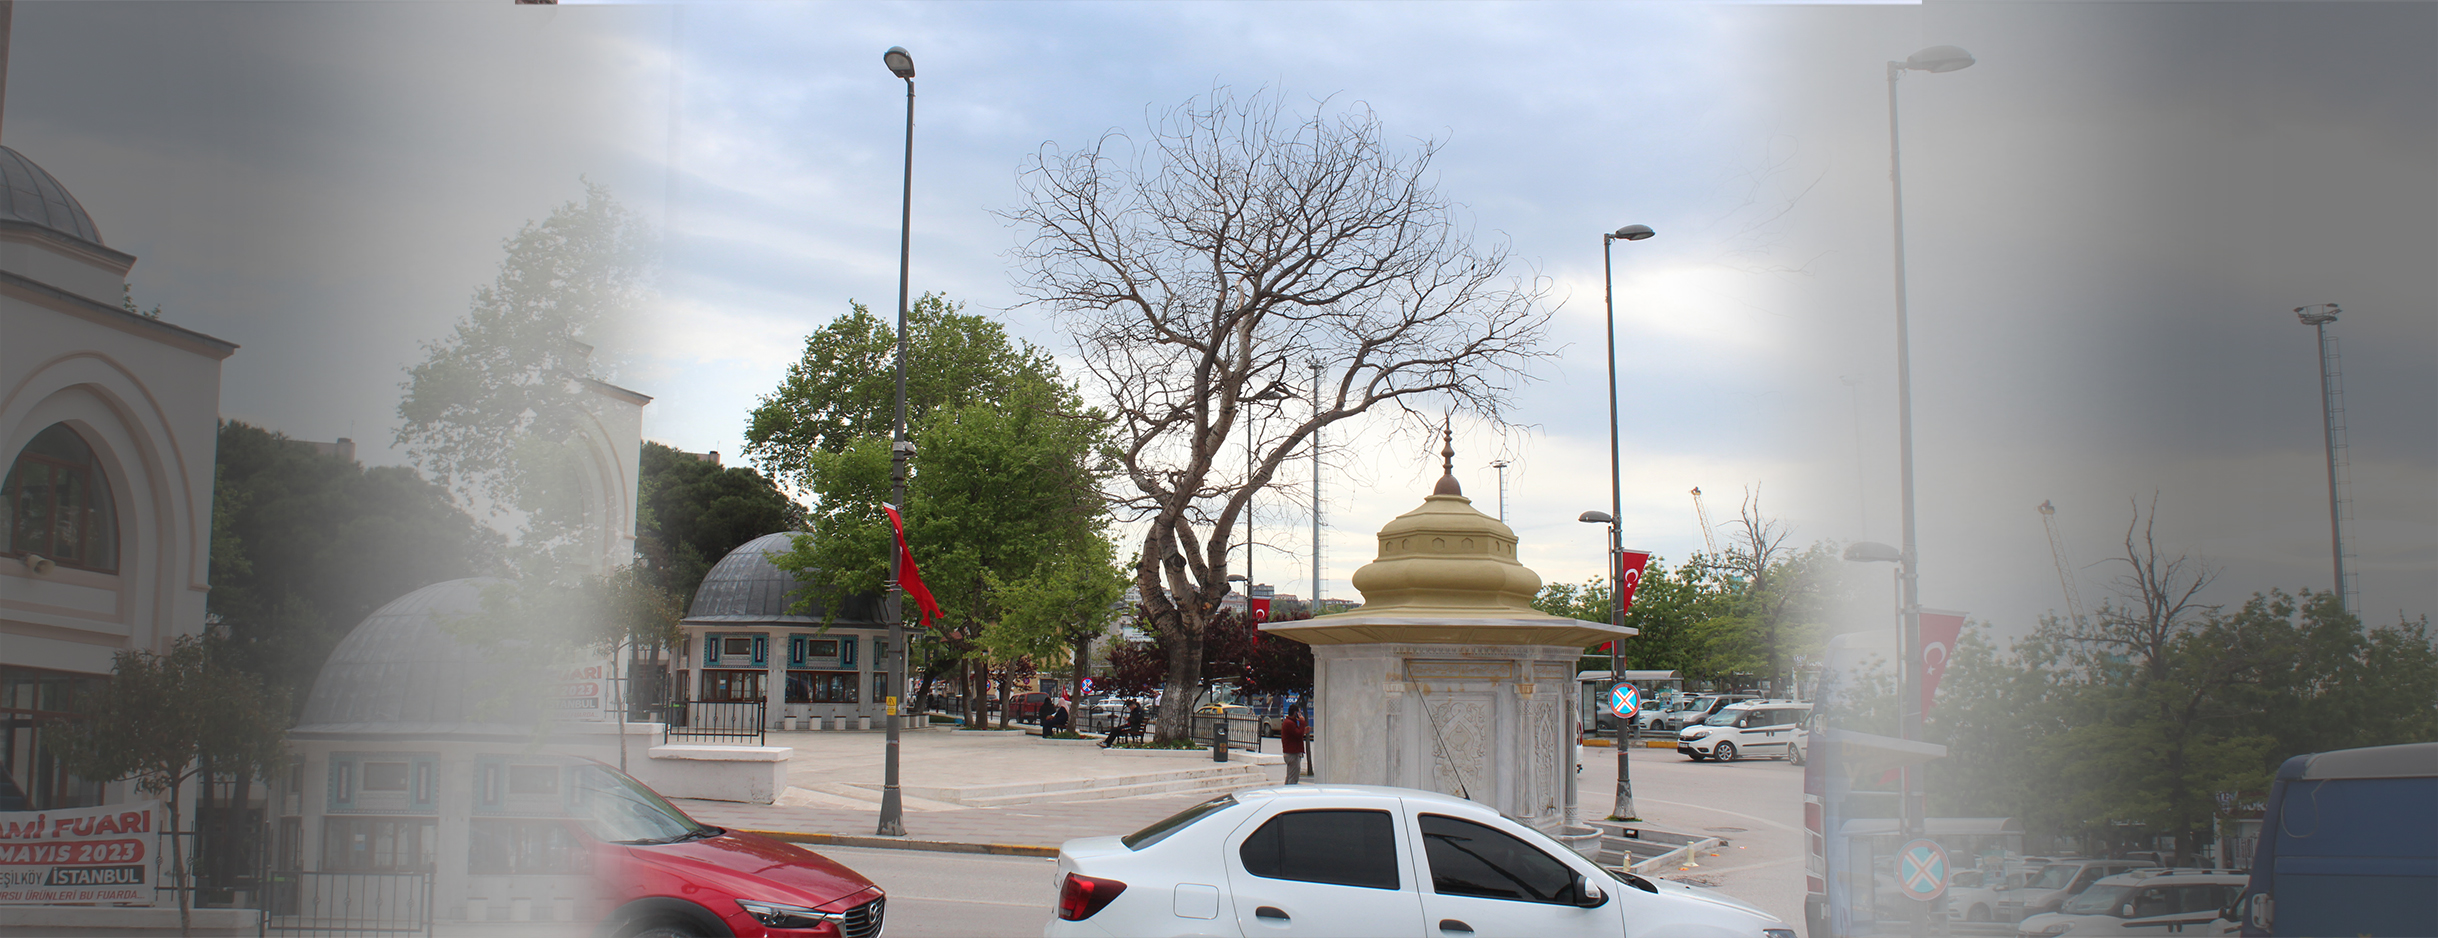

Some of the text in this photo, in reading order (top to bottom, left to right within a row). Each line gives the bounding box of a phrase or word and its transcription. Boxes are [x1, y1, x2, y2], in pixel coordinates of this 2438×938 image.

[52, 809, 151, 838] FUARI
[0, 843, 136, 863] MAYIS 2023
[53, 866, 140, 885] İSTANBUL
[25, 888, 78, 901] ÜRÜNLERİ
[79, 890, 94, 900] BU
